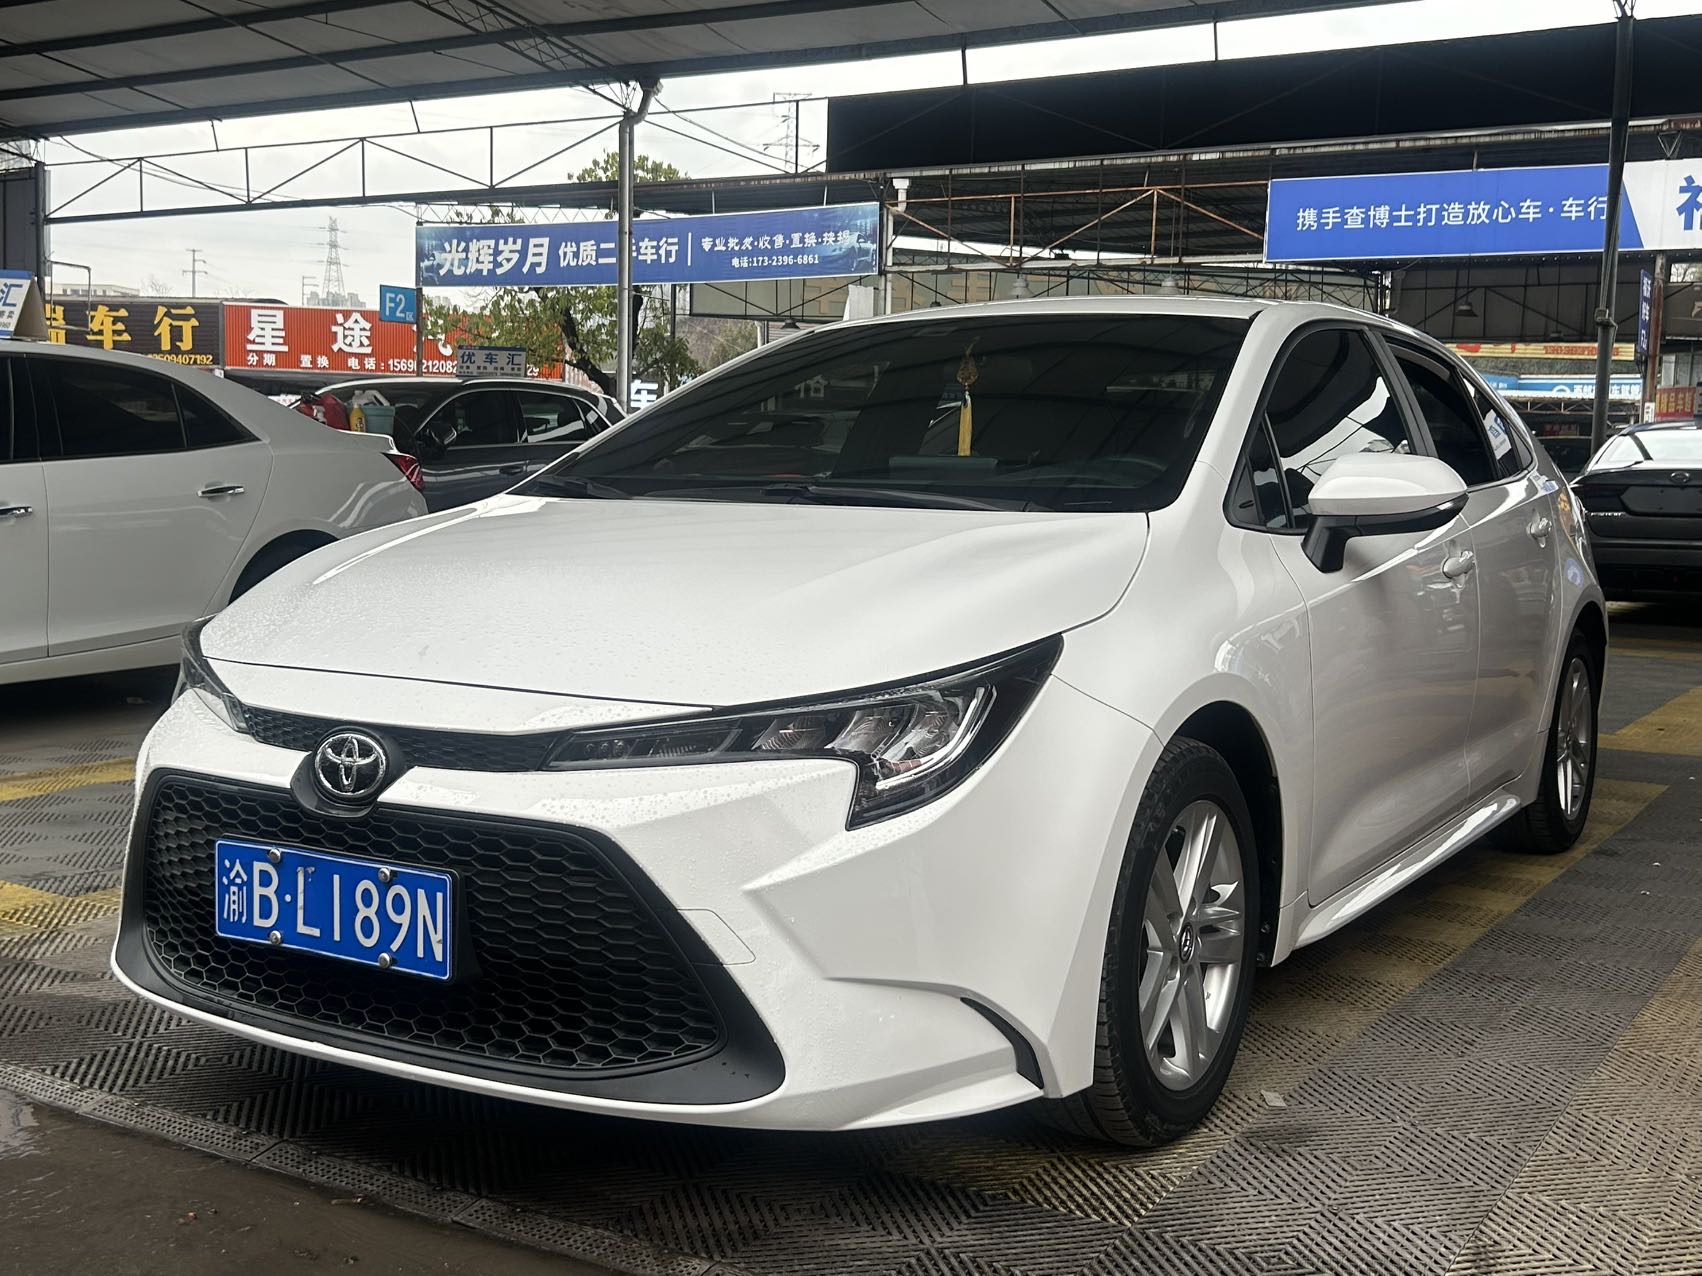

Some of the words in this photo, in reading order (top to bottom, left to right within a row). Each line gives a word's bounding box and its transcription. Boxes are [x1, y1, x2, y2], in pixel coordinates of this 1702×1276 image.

[1296, 196, 1608, 231] 携手查博士打造放心车·车行
[439, 237, 550, 275] 光辉岁月
[558, 237, 679, 267] 优质二车行
[247, 352, 276, 366] 分期
[300, 355, 329, 368] 置换
[460, 351, 522, 365] 优车汇
[223, 858, 443, 962] 渝B·L189N
